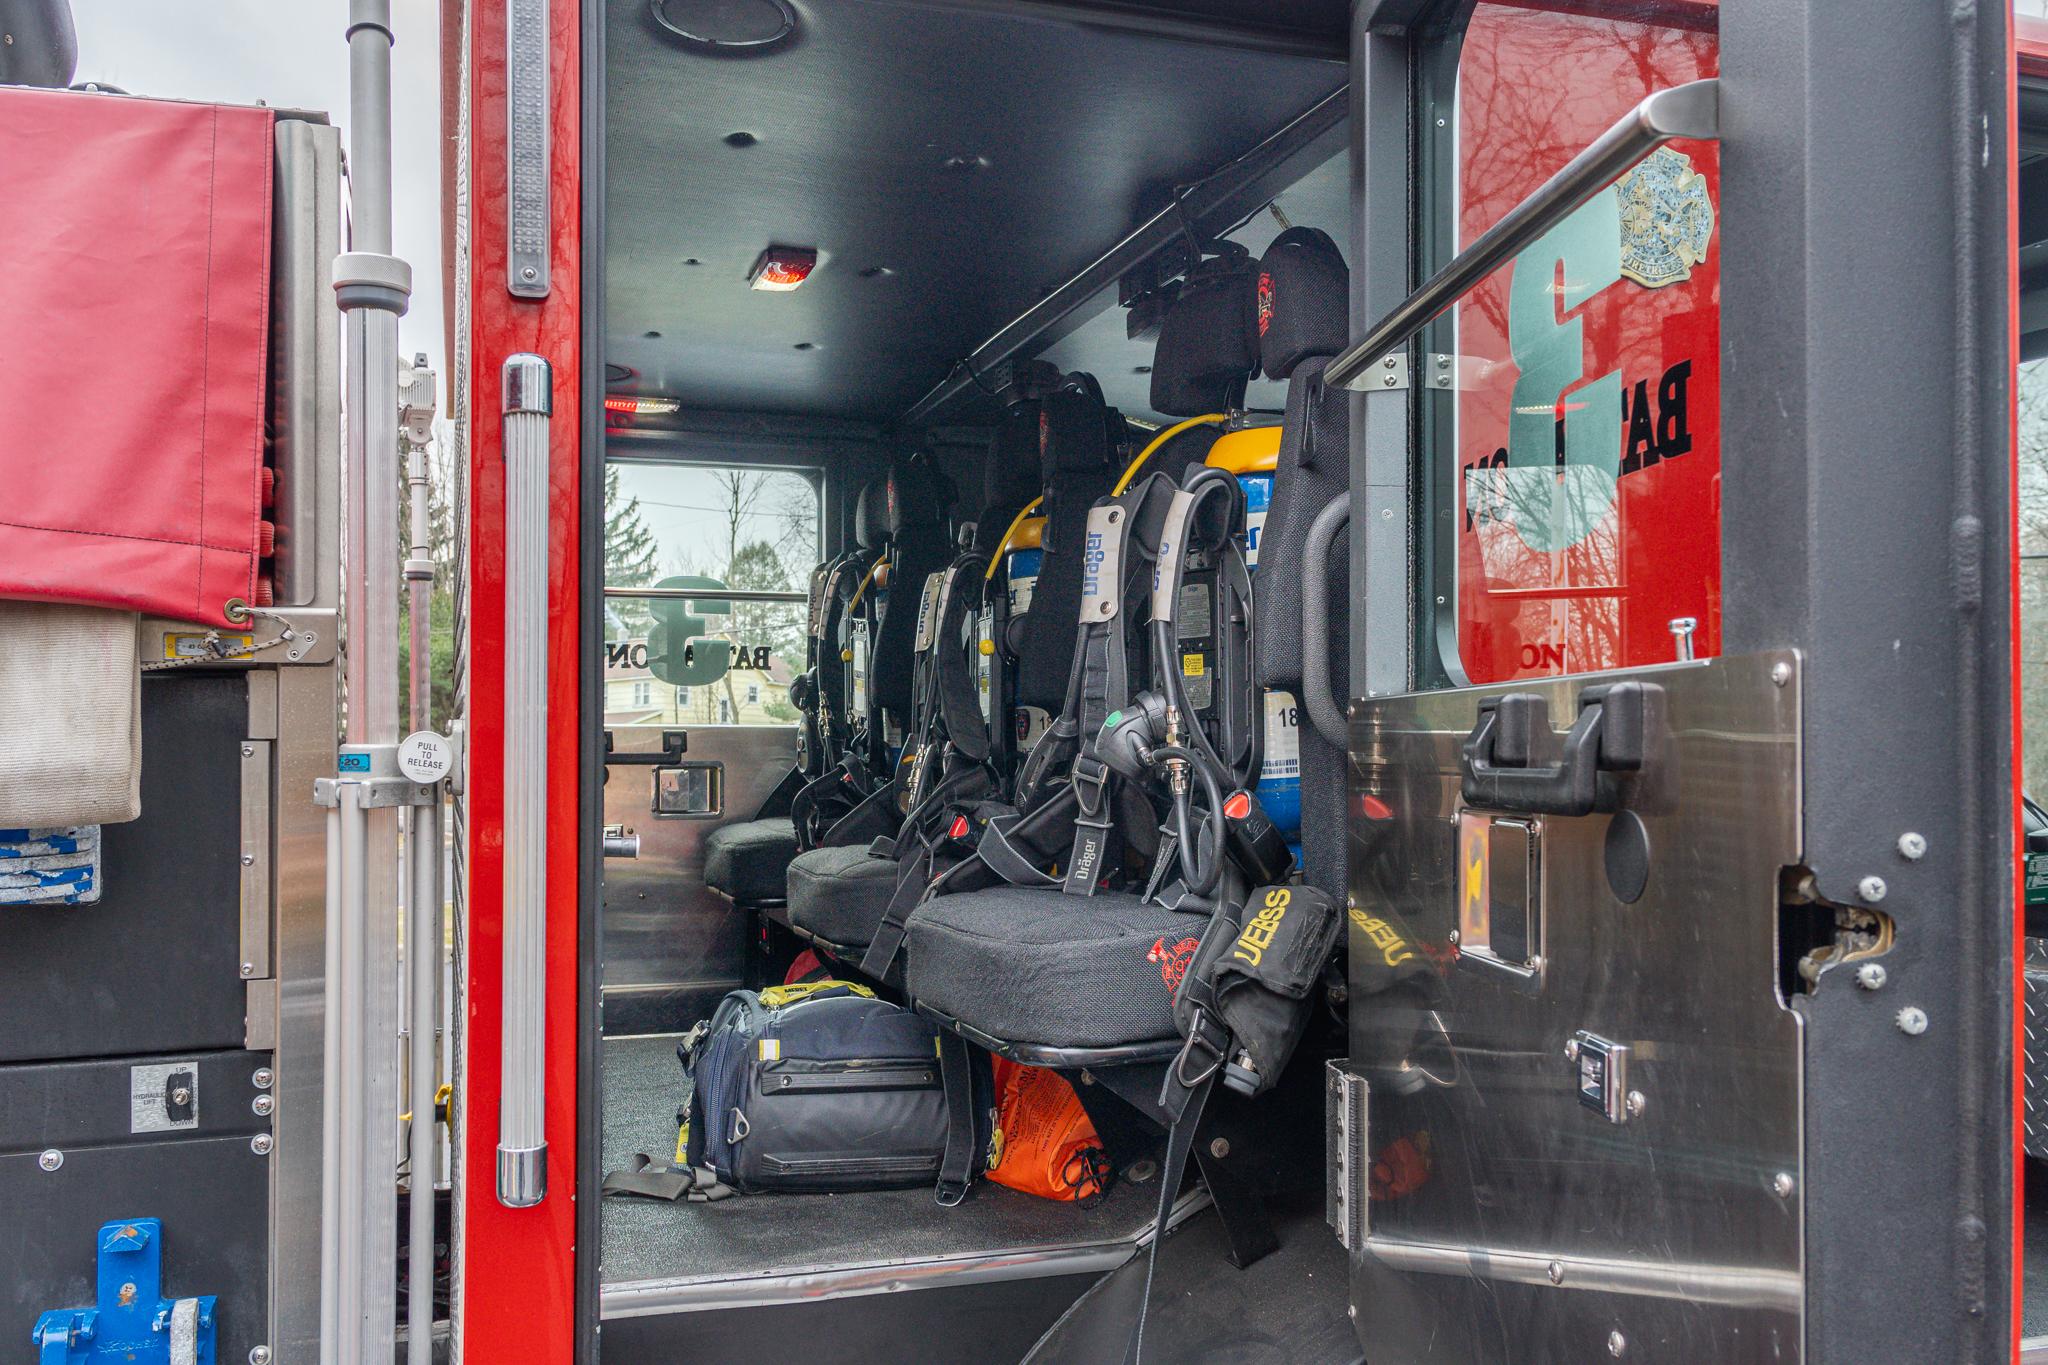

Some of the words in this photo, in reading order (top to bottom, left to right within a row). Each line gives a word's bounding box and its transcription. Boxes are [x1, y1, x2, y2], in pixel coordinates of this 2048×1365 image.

[1278, 707, 1299, 728] 18
[417, 741, 438, 752] PULL
[421, 750, 432, 760] TO
[407, 757, 444, 770] RELEASE
[1074, 838, 1097, 881] Dräger
